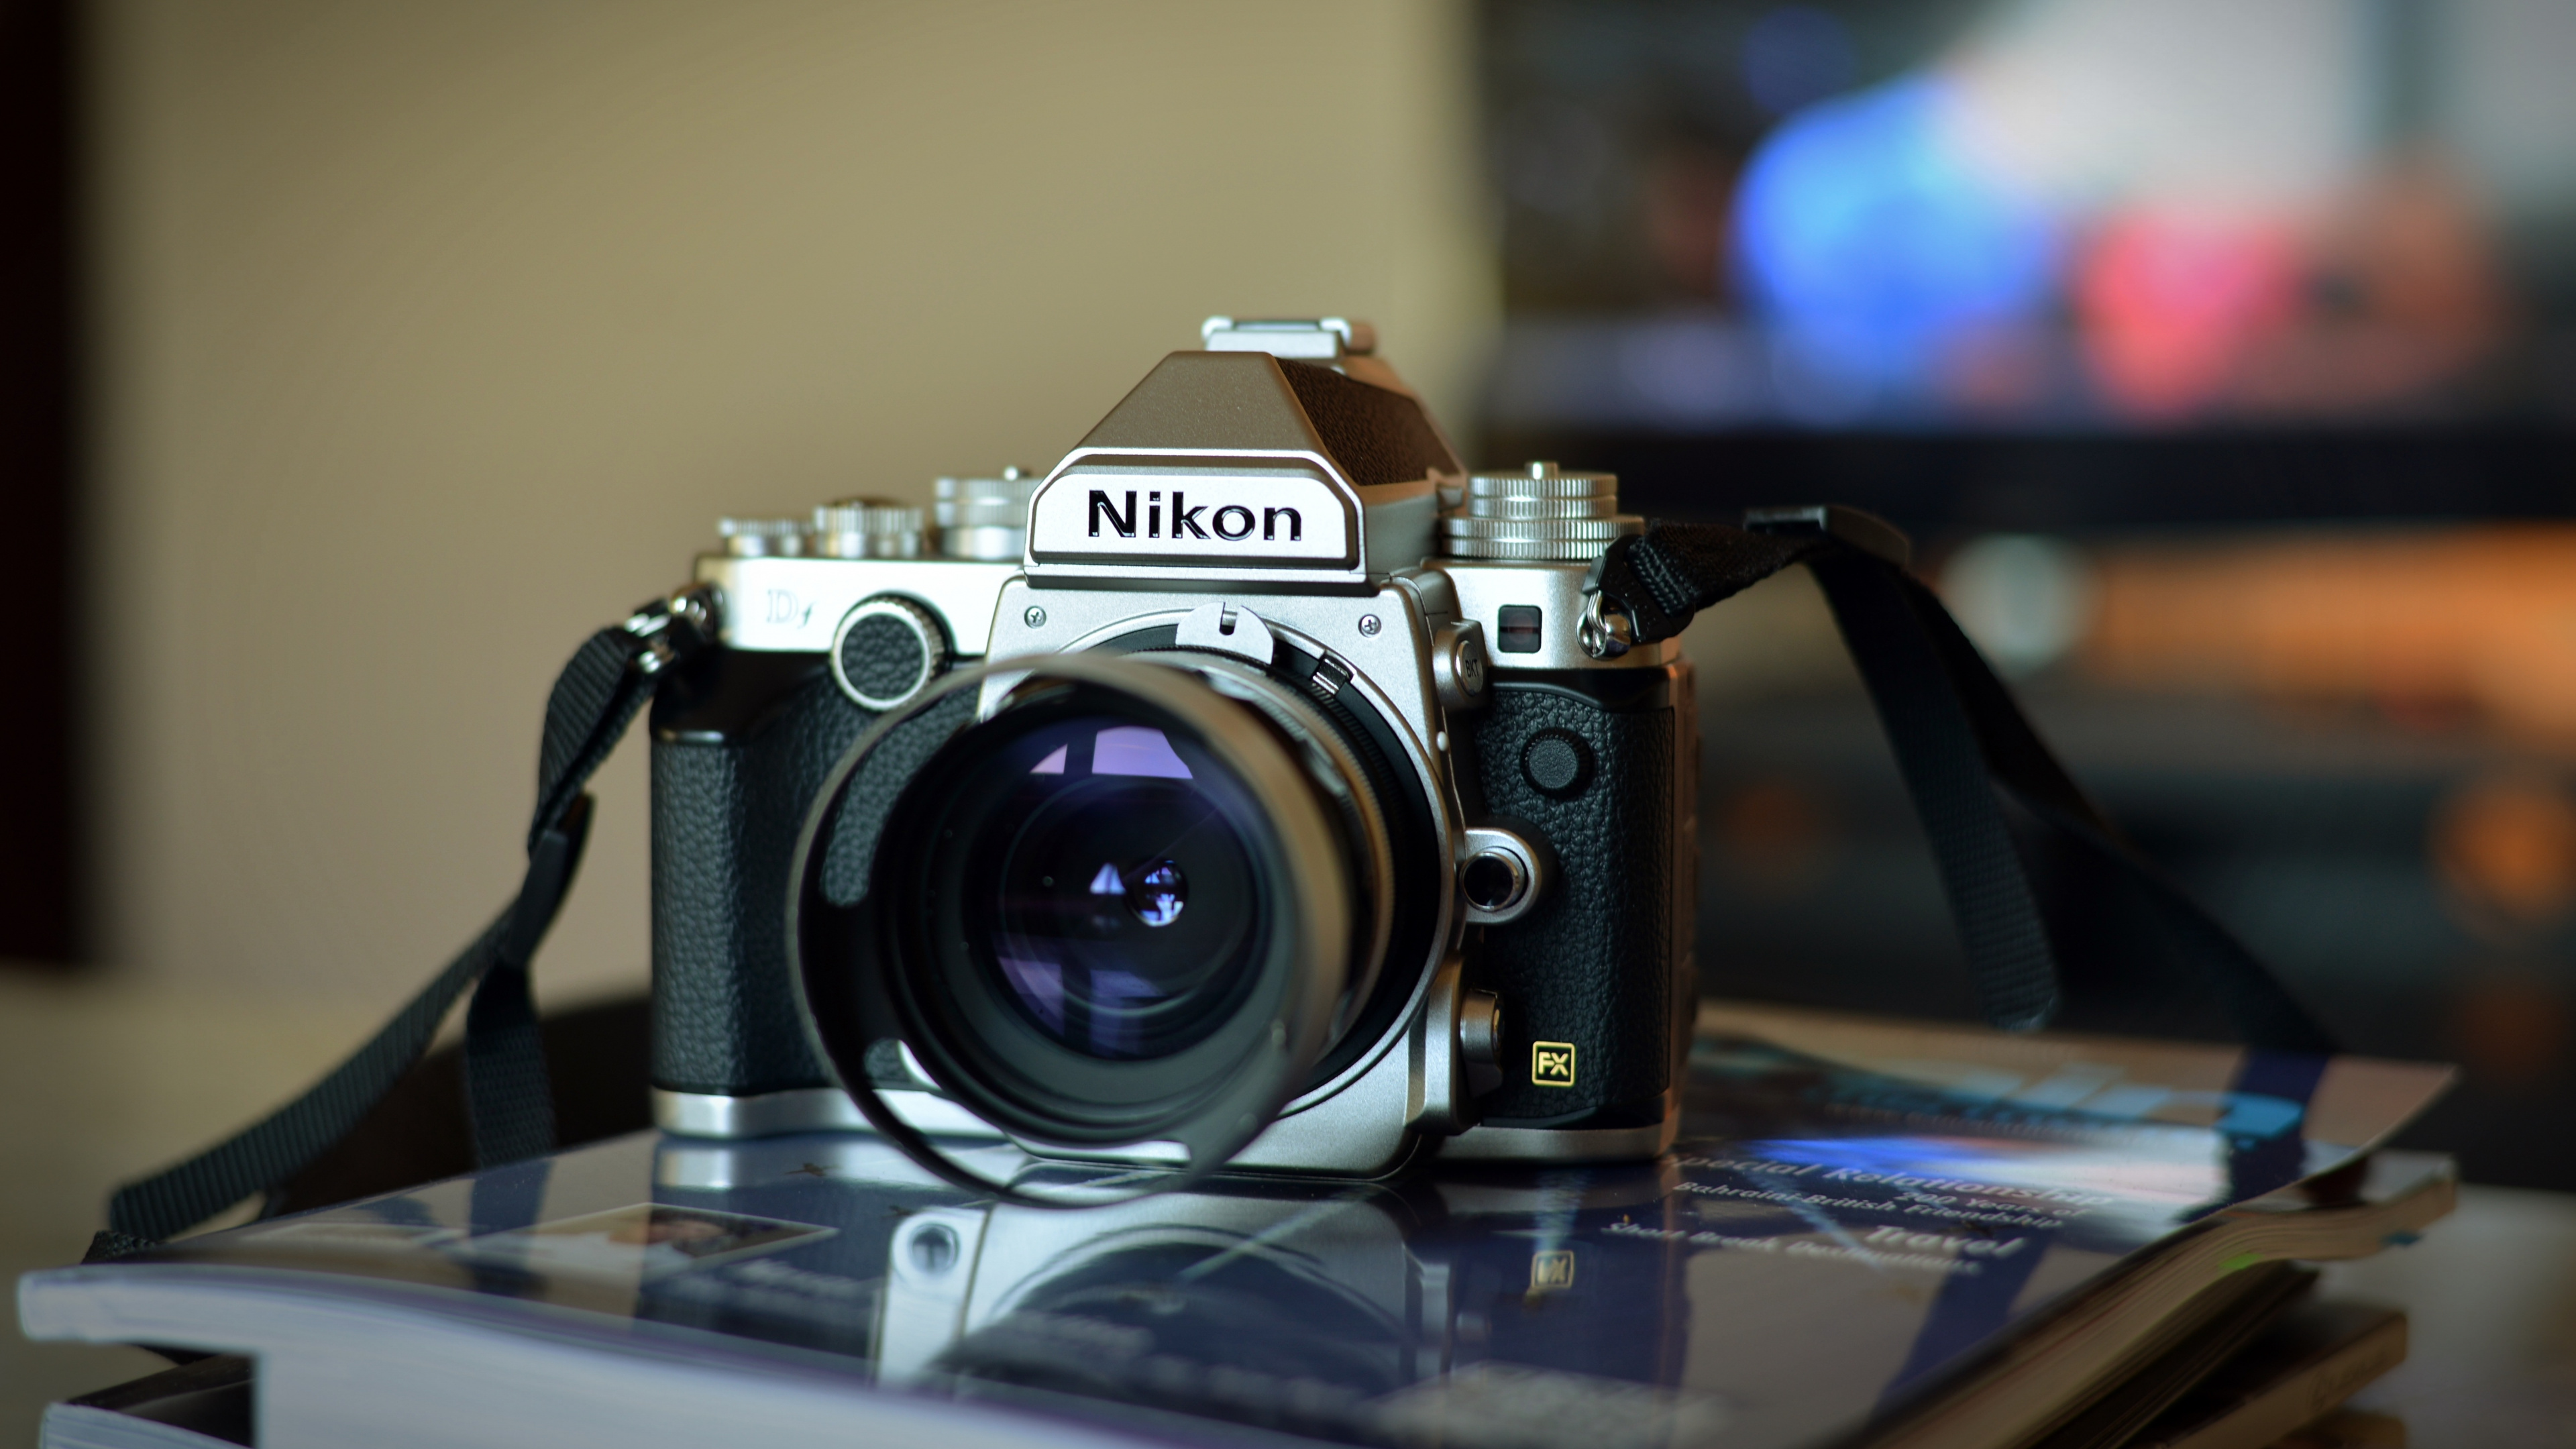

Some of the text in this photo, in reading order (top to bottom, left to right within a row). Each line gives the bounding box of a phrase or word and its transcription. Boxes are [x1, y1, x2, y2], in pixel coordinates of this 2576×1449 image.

[1087, 490, 1302, 541] Nikon
[766, 588, 817, 629] Df
[1465, 659, 1479, 678] BKT
[1538, 1051, 1569, 1077] FX
[1822, 1167, 2114, 1206] Relationship
[1893, 1191, 2092, 1218] 200 Years of
[1672, 1181, 2064, 1229] Bahraini-British Friendship
[1865, 1225, 2027, 1258] Travel
